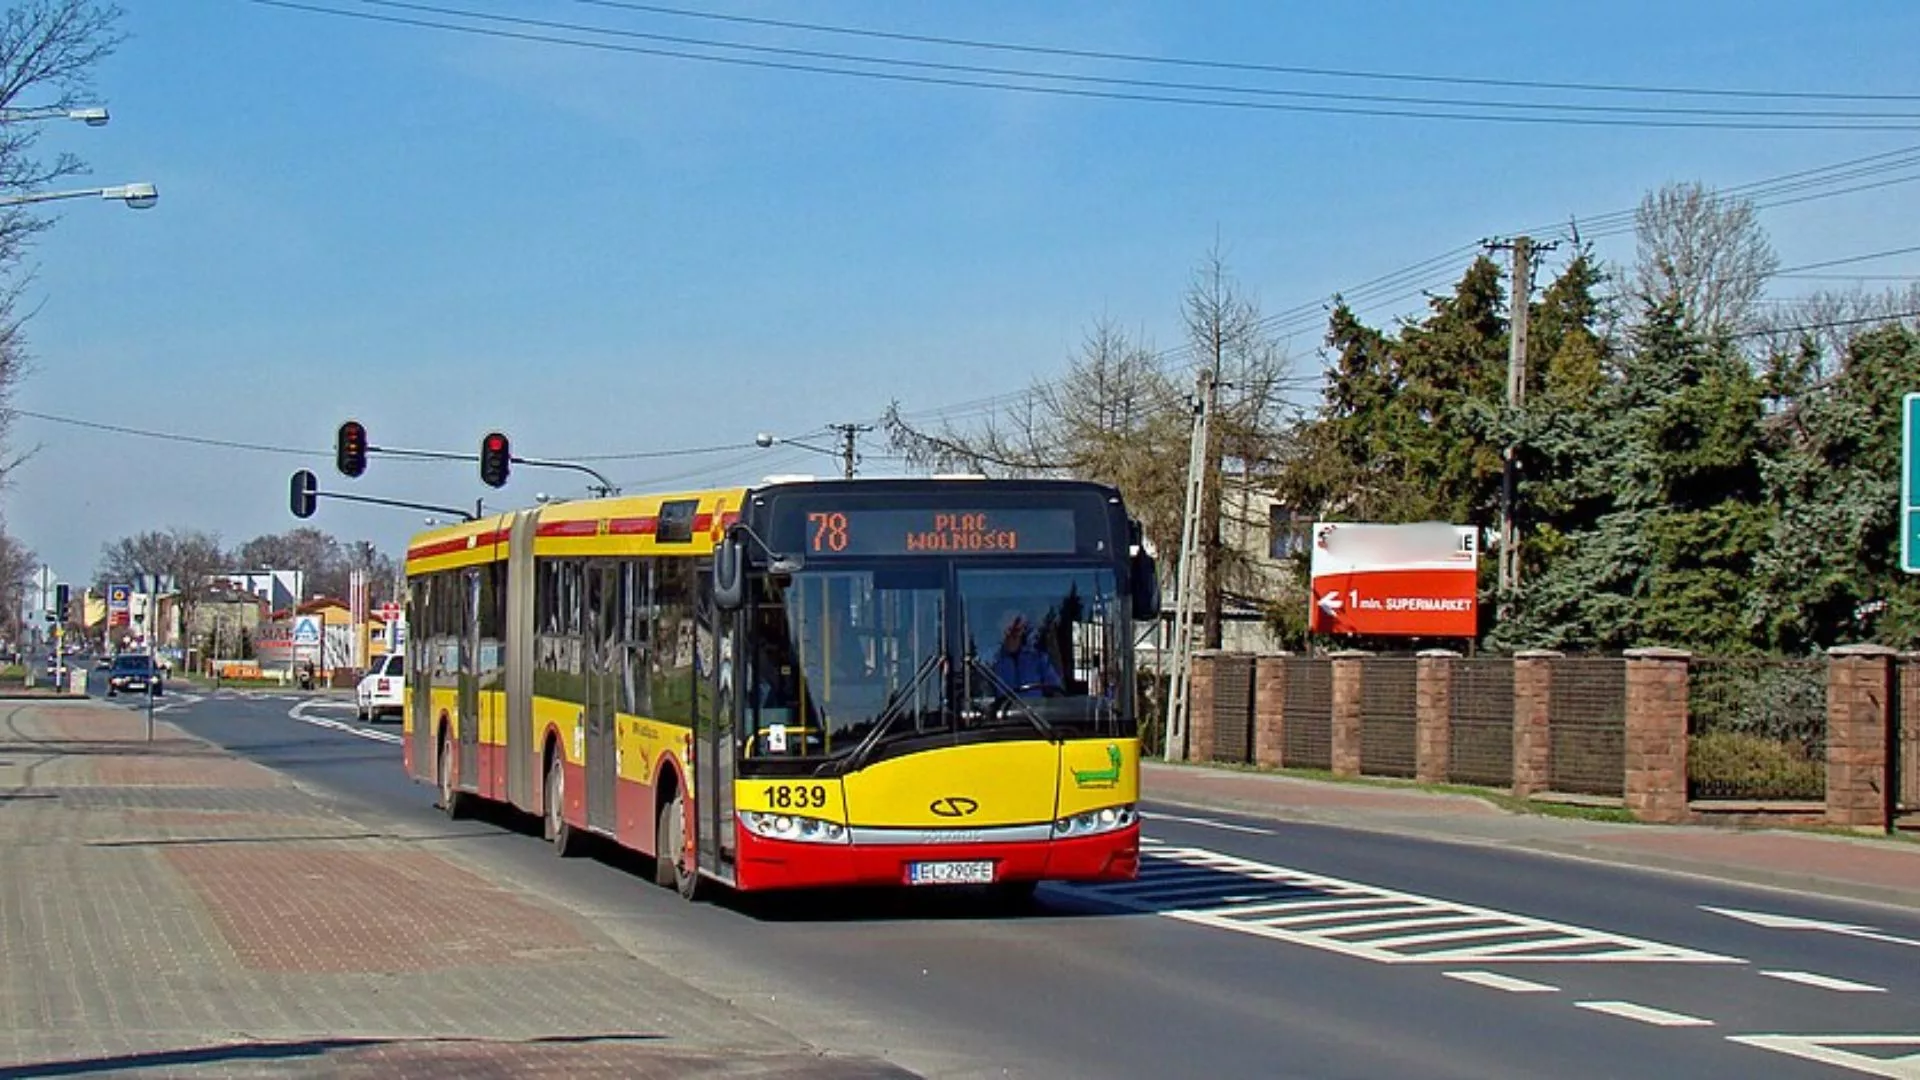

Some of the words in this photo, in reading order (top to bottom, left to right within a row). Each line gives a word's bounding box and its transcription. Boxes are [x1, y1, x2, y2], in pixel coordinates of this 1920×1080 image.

[807, 512, 848, 551] 78
[935, 513, 987, 531] PLAC
[907, 529, 1017, 550] WOLNOŚCI
[1349, 589, 1359, 609] 1
[1386, 598, 1472, 612] SUPERMARKET
[764, 785, 826, 808] 1839
